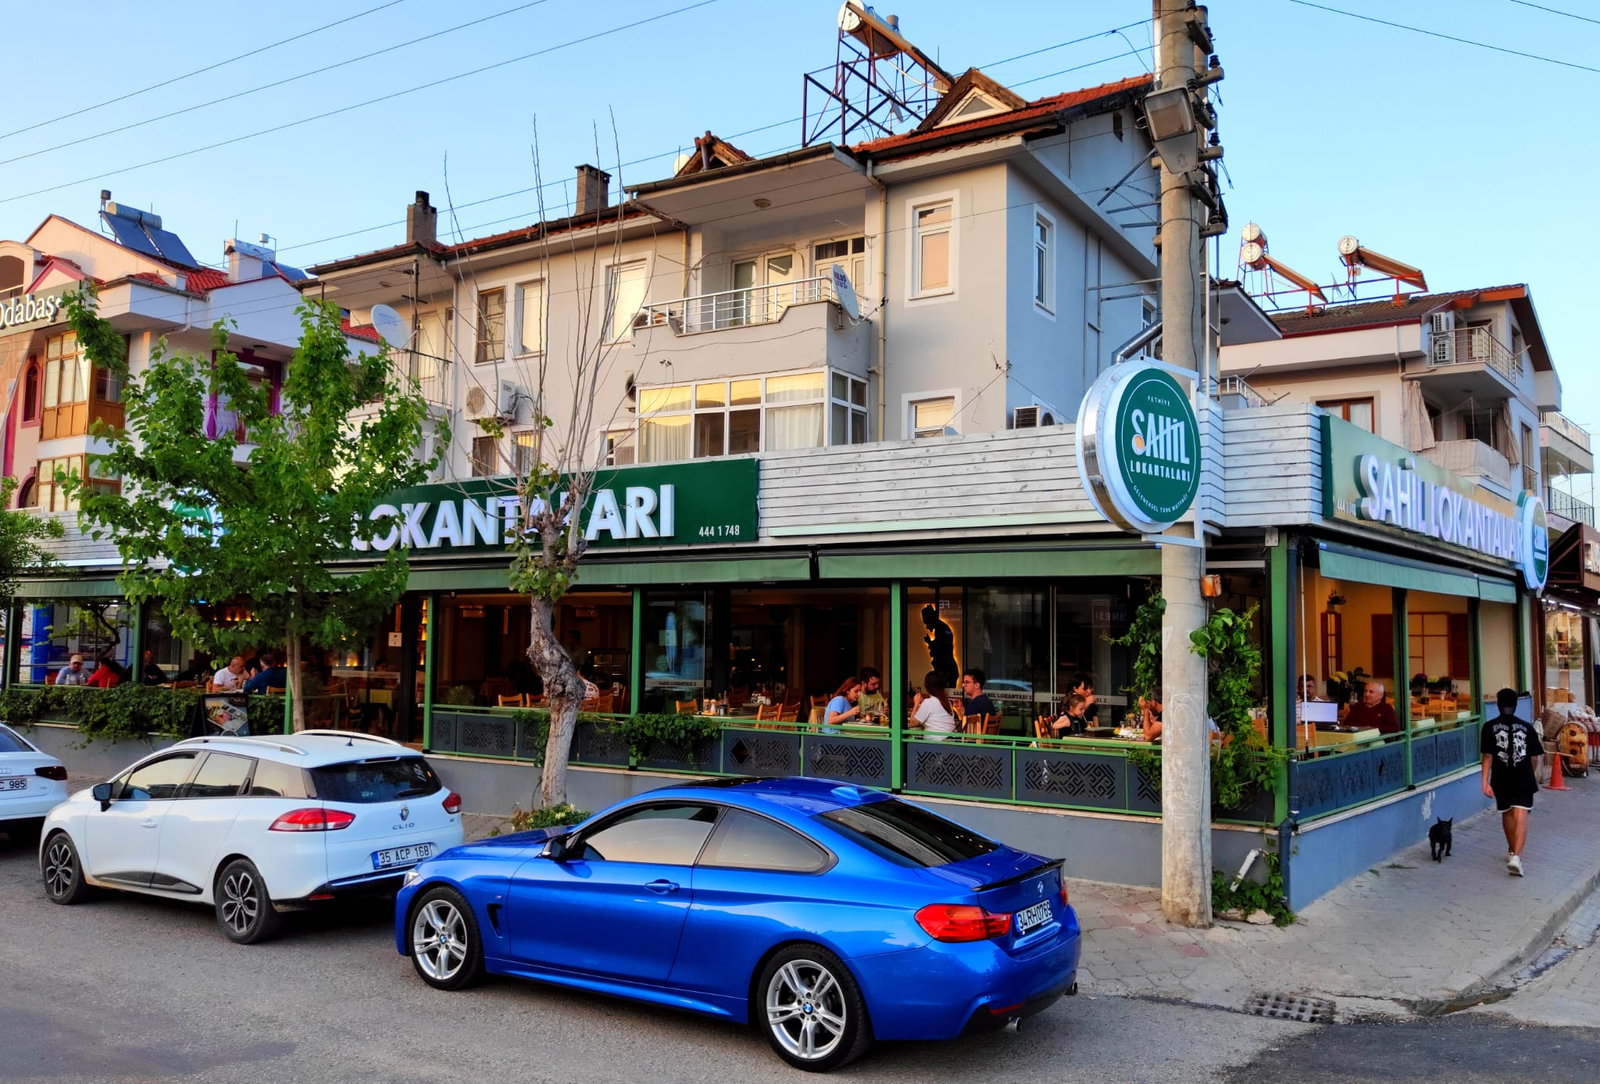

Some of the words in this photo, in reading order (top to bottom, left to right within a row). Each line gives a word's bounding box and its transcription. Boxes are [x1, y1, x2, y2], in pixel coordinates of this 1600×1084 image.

[1130, 460, 1190, 482] LOKANTALARI
[1360, 454, 1429, 533] SAHİL
[1429, 485, 1525, 565] LOKANTALAR
[698, 525, 715, 537] 444
[717, 525, 722, 537] 1
[724, 524, 740, 536] 748
[9, 780, 26, 789] 985
[392, 822, 415, 830] CLIO
[379, 851, 391, 864] 35
[395, 848, 411, 861] ACP
[414, 844, 430, 857] 168
